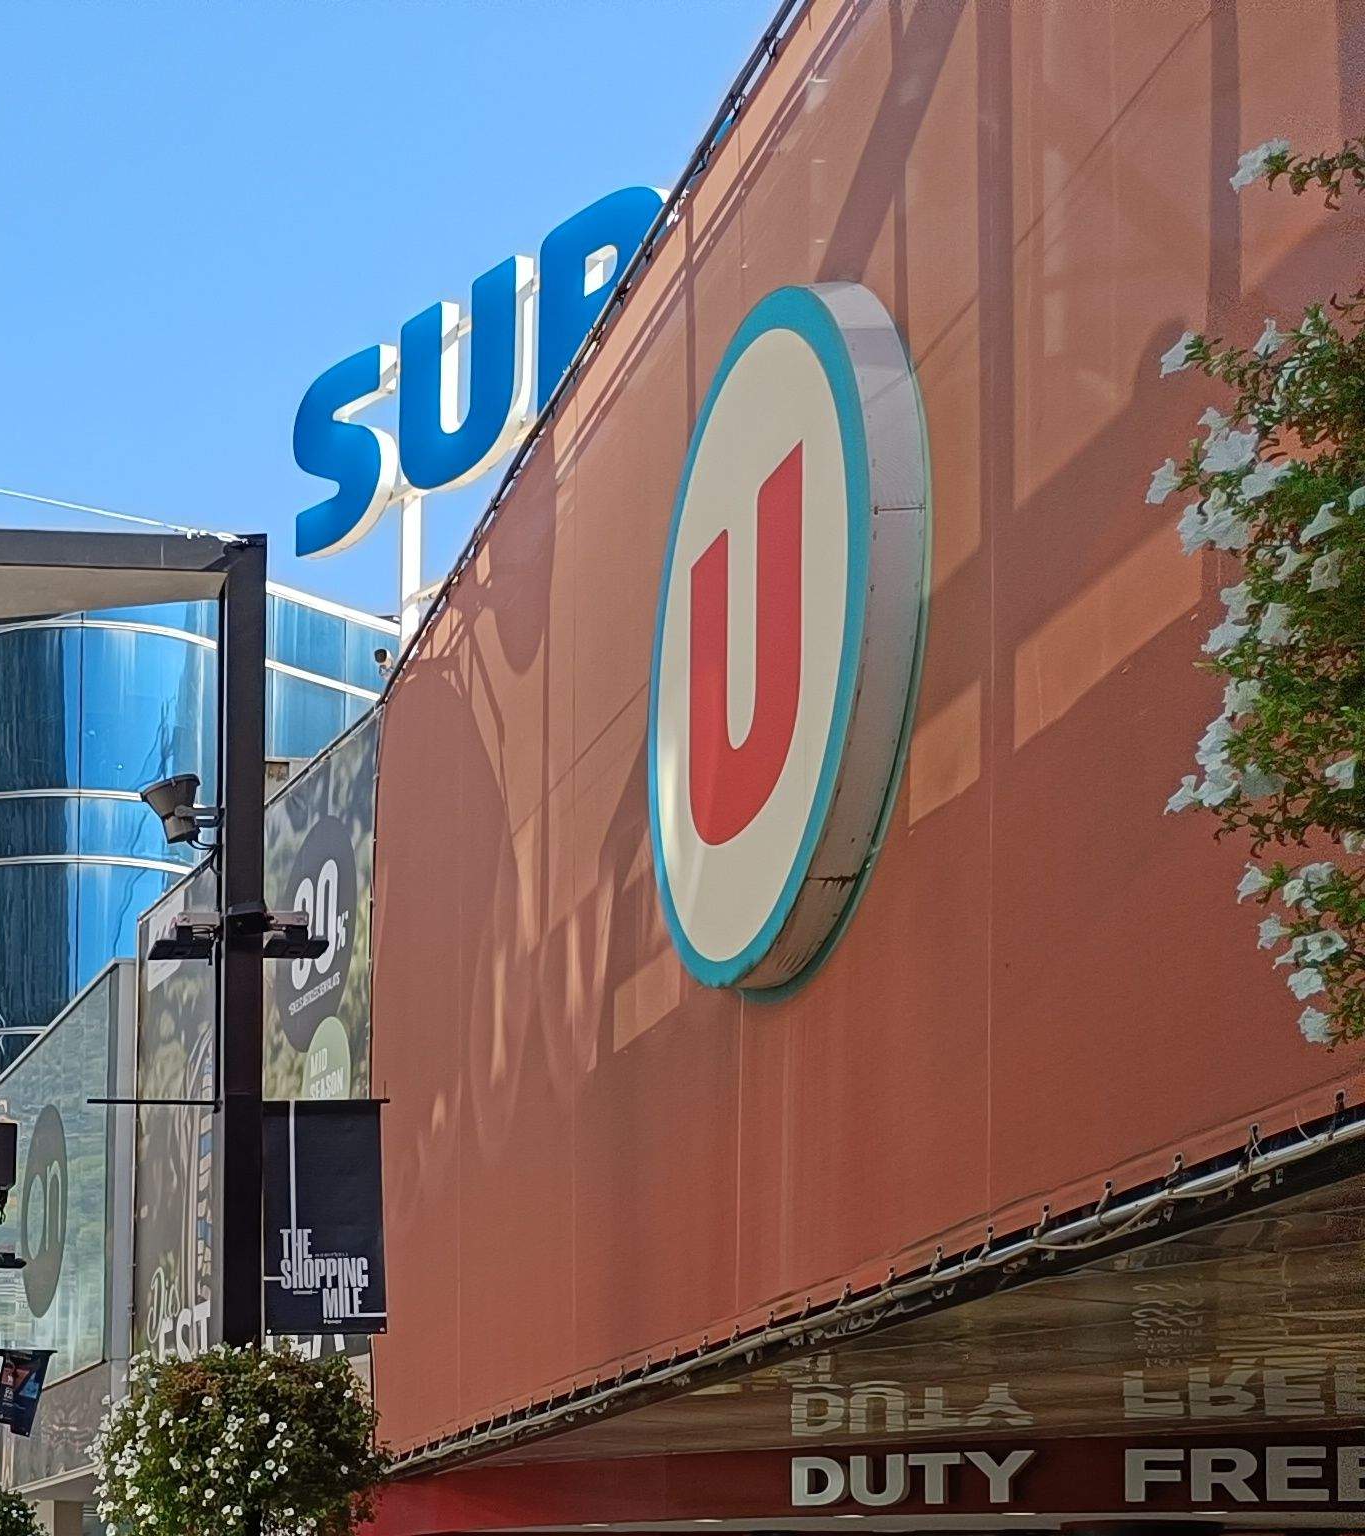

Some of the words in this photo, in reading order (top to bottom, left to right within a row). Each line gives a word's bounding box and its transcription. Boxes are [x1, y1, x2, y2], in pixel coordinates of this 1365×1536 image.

[688, 439, 805, 847] U
[310, 1048, 328, 1078] MID
[279, 1228, 312, 1258] THE
[280, 1257, 369, 1289] SHOPPING
[322, 1287, 363, 1318] MILE
[790, 1449, 1036, 1507] DUTY
